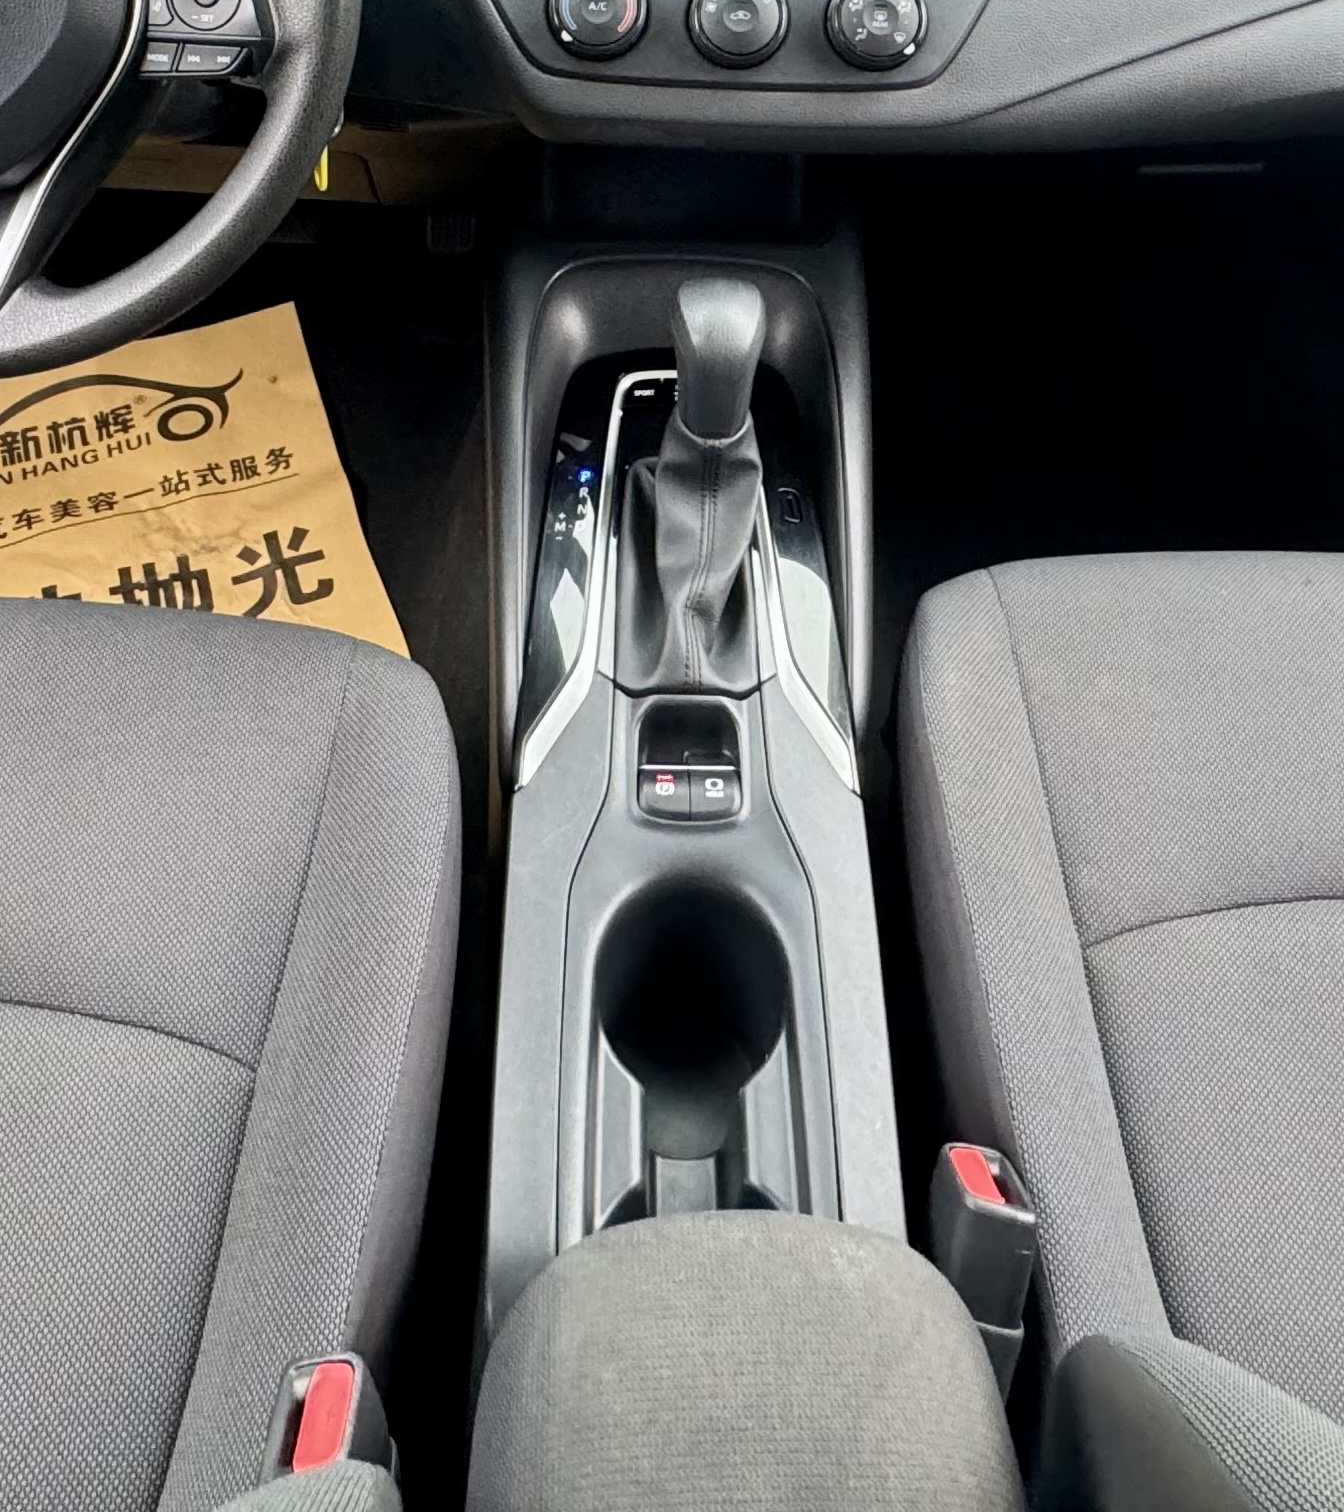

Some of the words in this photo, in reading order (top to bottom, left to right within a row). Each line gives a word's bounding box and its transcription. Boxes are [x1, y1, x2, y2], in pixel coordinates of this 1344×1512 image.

[588, 1, 607, 11] A/C
[633, 389, 655, 397] SPORT
[21, 448, 100, 481] HANG
[106, 431, 152, 459] HUI
[35, 526, 336, 619] 抛光
